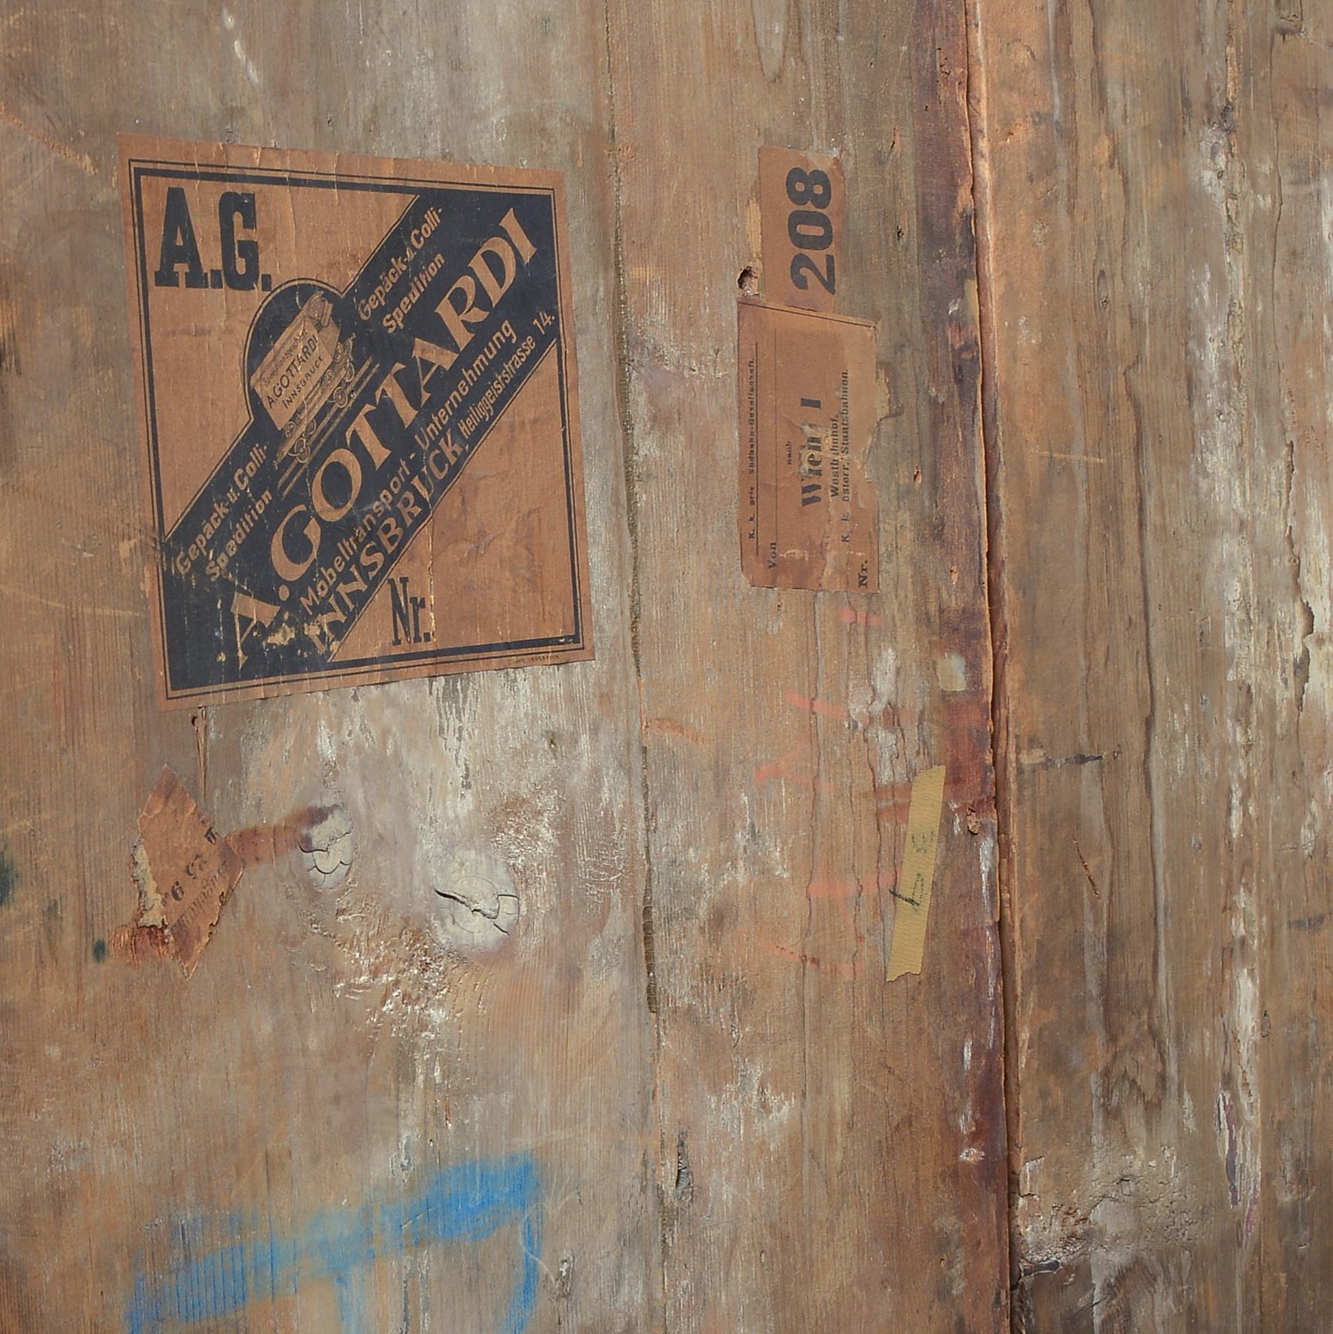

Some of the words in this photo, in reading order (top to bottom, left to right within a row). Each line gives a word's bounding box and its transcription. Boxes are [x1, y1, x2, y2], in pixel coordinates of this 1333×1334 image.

[154, 186, 272, 292] A.G.
[785, 166, 837, 295] 208
[381, 252, 446, 334] Spedition
[532, 312, 557, 337] 14.
[282, 356, 324, 410] INNSBRUCK
[800, 436, 823, 507] Wien
[205, 489, 273, 583] Spedition
[767, 541, 778, 569] Von
[857, 559, 869, 588] Nr.
[388, 576, 431, 646] Nr.
